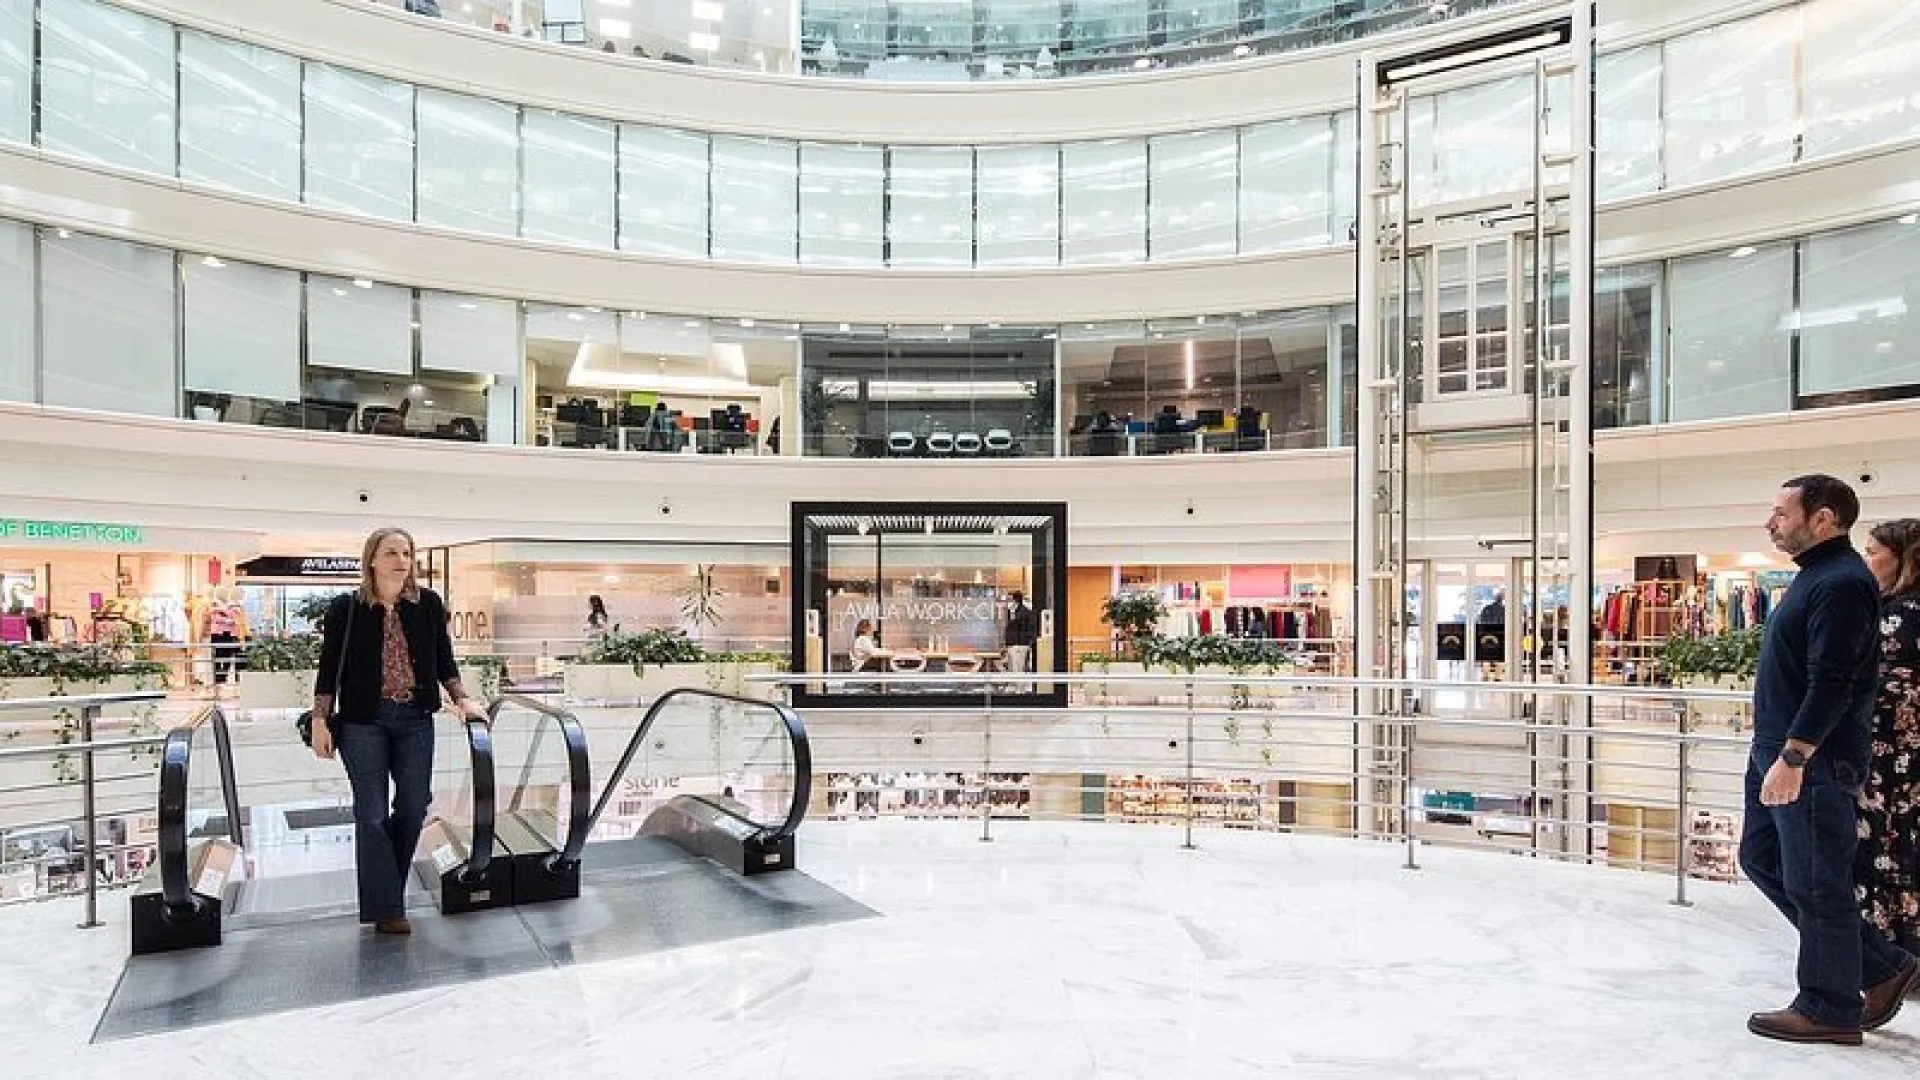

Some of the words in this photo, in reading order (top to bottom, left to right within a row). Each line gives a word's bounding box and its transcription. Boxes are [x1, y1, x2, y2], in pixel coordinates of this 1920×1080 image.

[25, 521, 142, 542] BENETTON
[906, 602, 968, 620] WORK
[973, 602, 1018, 620] CITY
